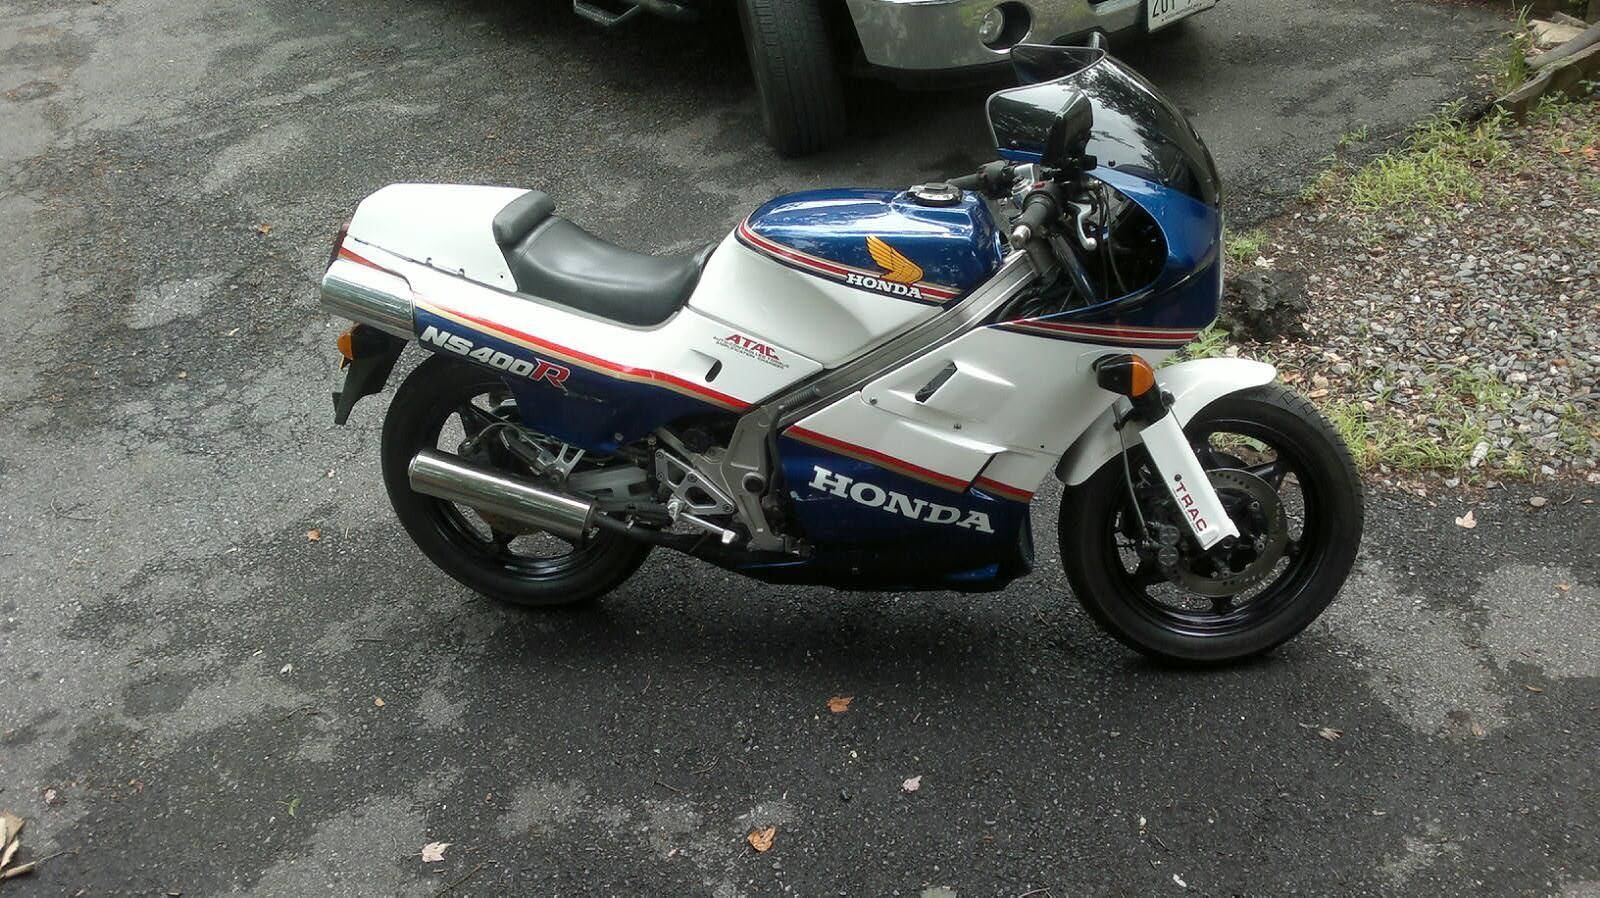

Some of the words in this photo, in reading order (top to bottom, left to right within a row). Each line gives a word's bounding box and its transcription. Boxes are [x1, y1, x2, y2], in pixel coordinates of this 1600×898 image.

[845, 272, 922, 299] HONDA
[419, 325, 571, 389] NS400R
[725, 333, 780, 360] ATAC
[808, 465, 995, 534] HONDA
[1175, 482, 1208, 532] TRAC
